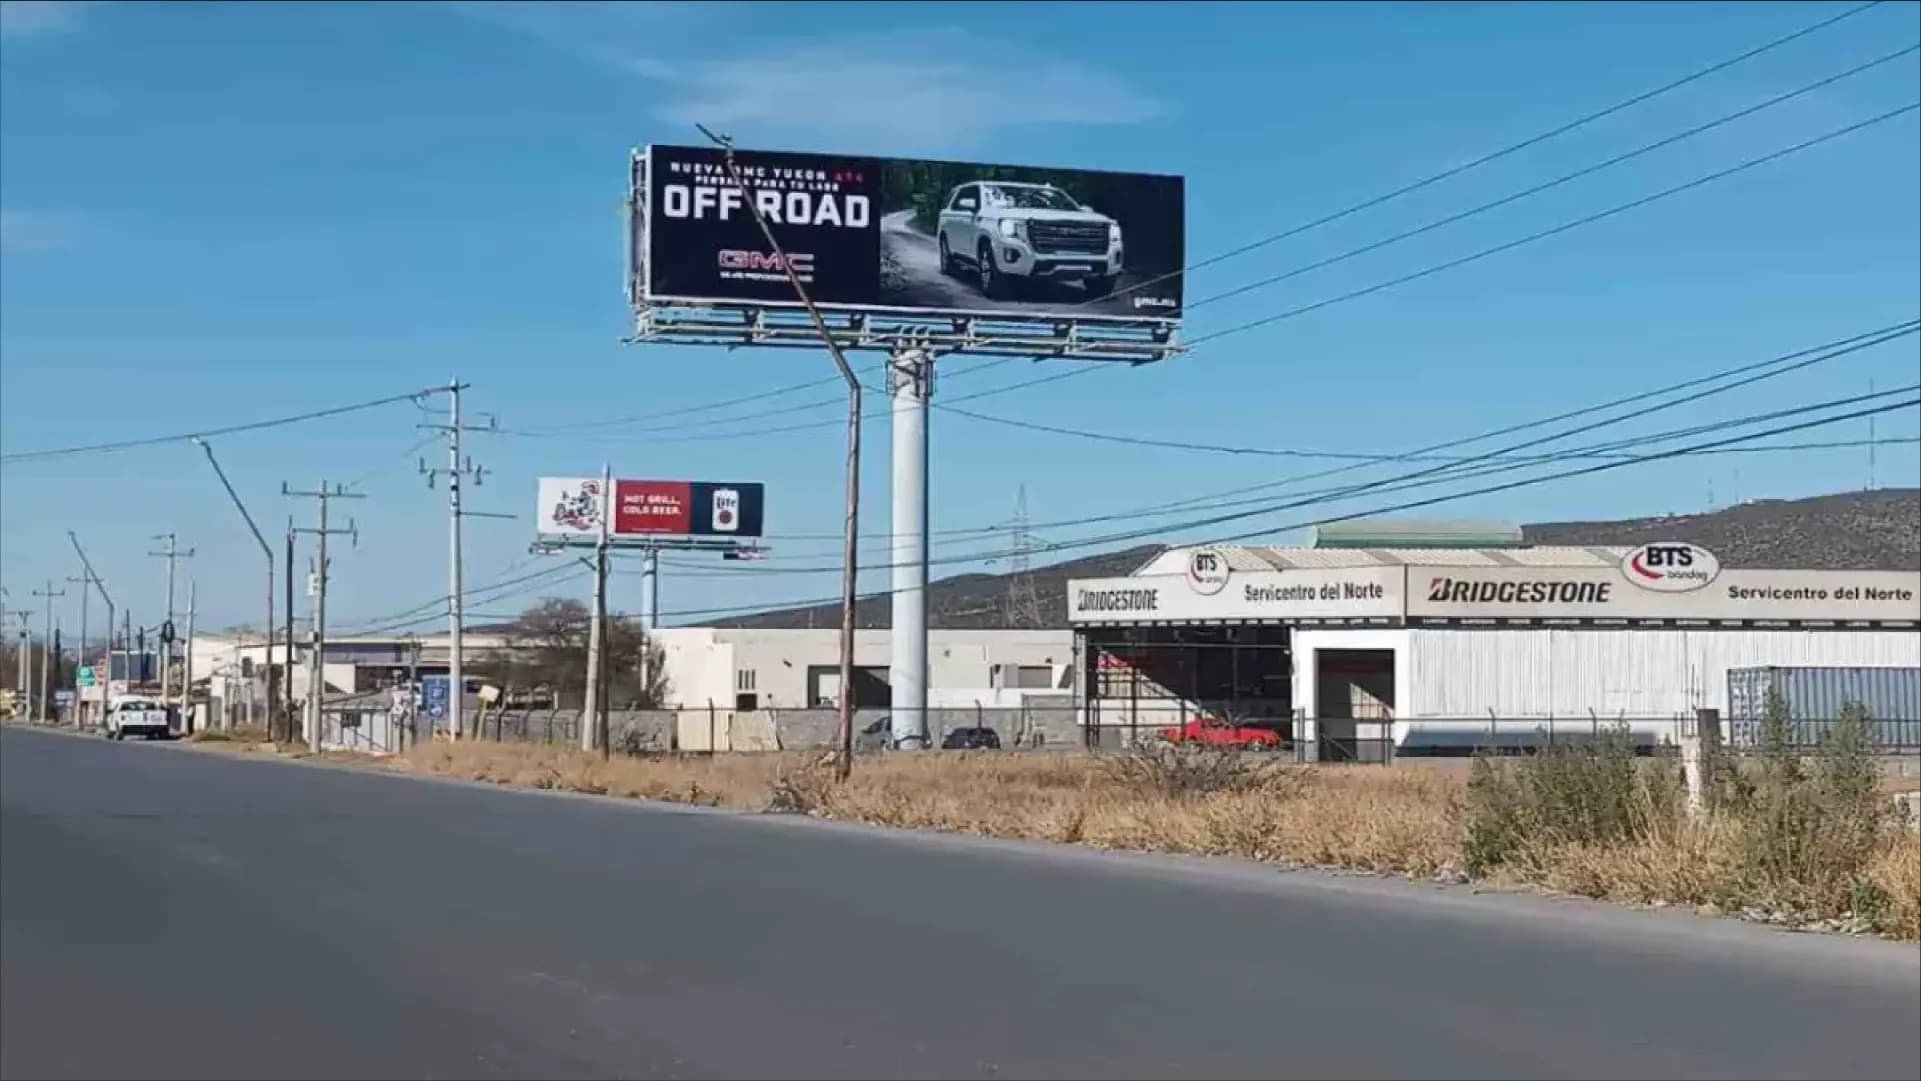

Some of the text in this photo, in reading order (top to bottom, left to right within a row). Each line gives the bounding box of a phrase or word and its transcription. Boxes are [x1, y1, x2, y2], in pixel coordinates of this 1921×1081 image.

[670, 161, 724, 174] NUEVA
[773, 168, 826, 181] YUKON
[664, 184, 869, 228] OFF ROAD
[718, 249, 814, 272] GMC
[1196, 552, 1217, 571] BTS
[1646, 546, 1692, 567] BTS
[1077, 588, 1159, 612] BRIDGESTONE
[1244, 580, 1383, 602] Servicentro del Norte
[1428, 577, 1613, 603] BRIDGESTONE
[1728, 585, 1913, 601] Servicentro del Norte
